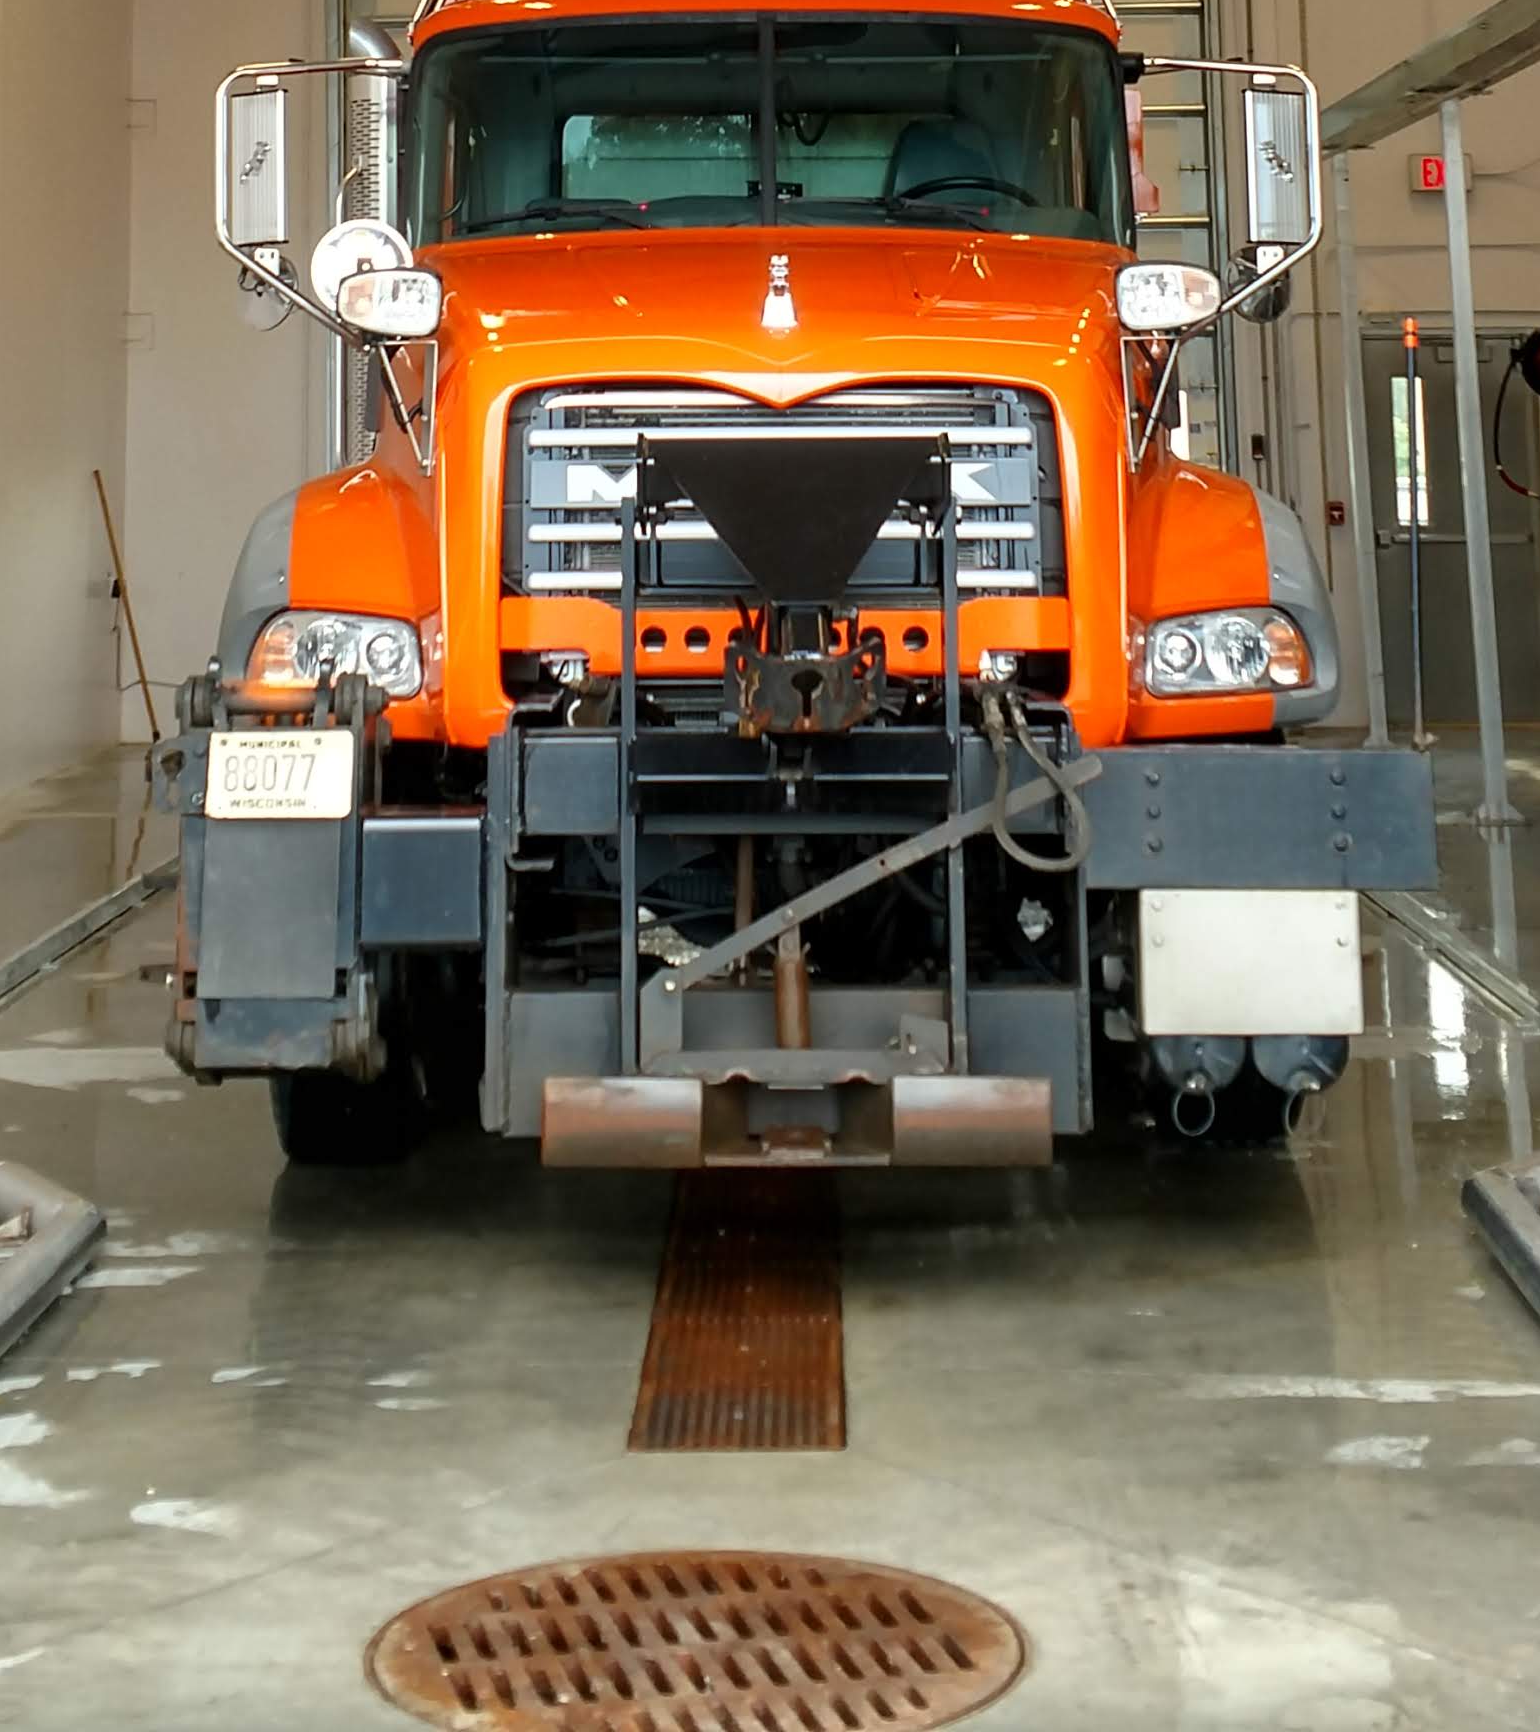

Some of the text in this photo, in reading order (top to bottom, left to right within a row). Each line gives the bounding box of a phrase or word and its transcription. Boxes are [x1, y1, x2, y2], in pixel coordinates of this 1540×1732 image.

[239, 739, 302, 749] MUNICIPAL
[223, 753, 317, 792] 88077
[229, 798, 306, 809] WISCONSIN
